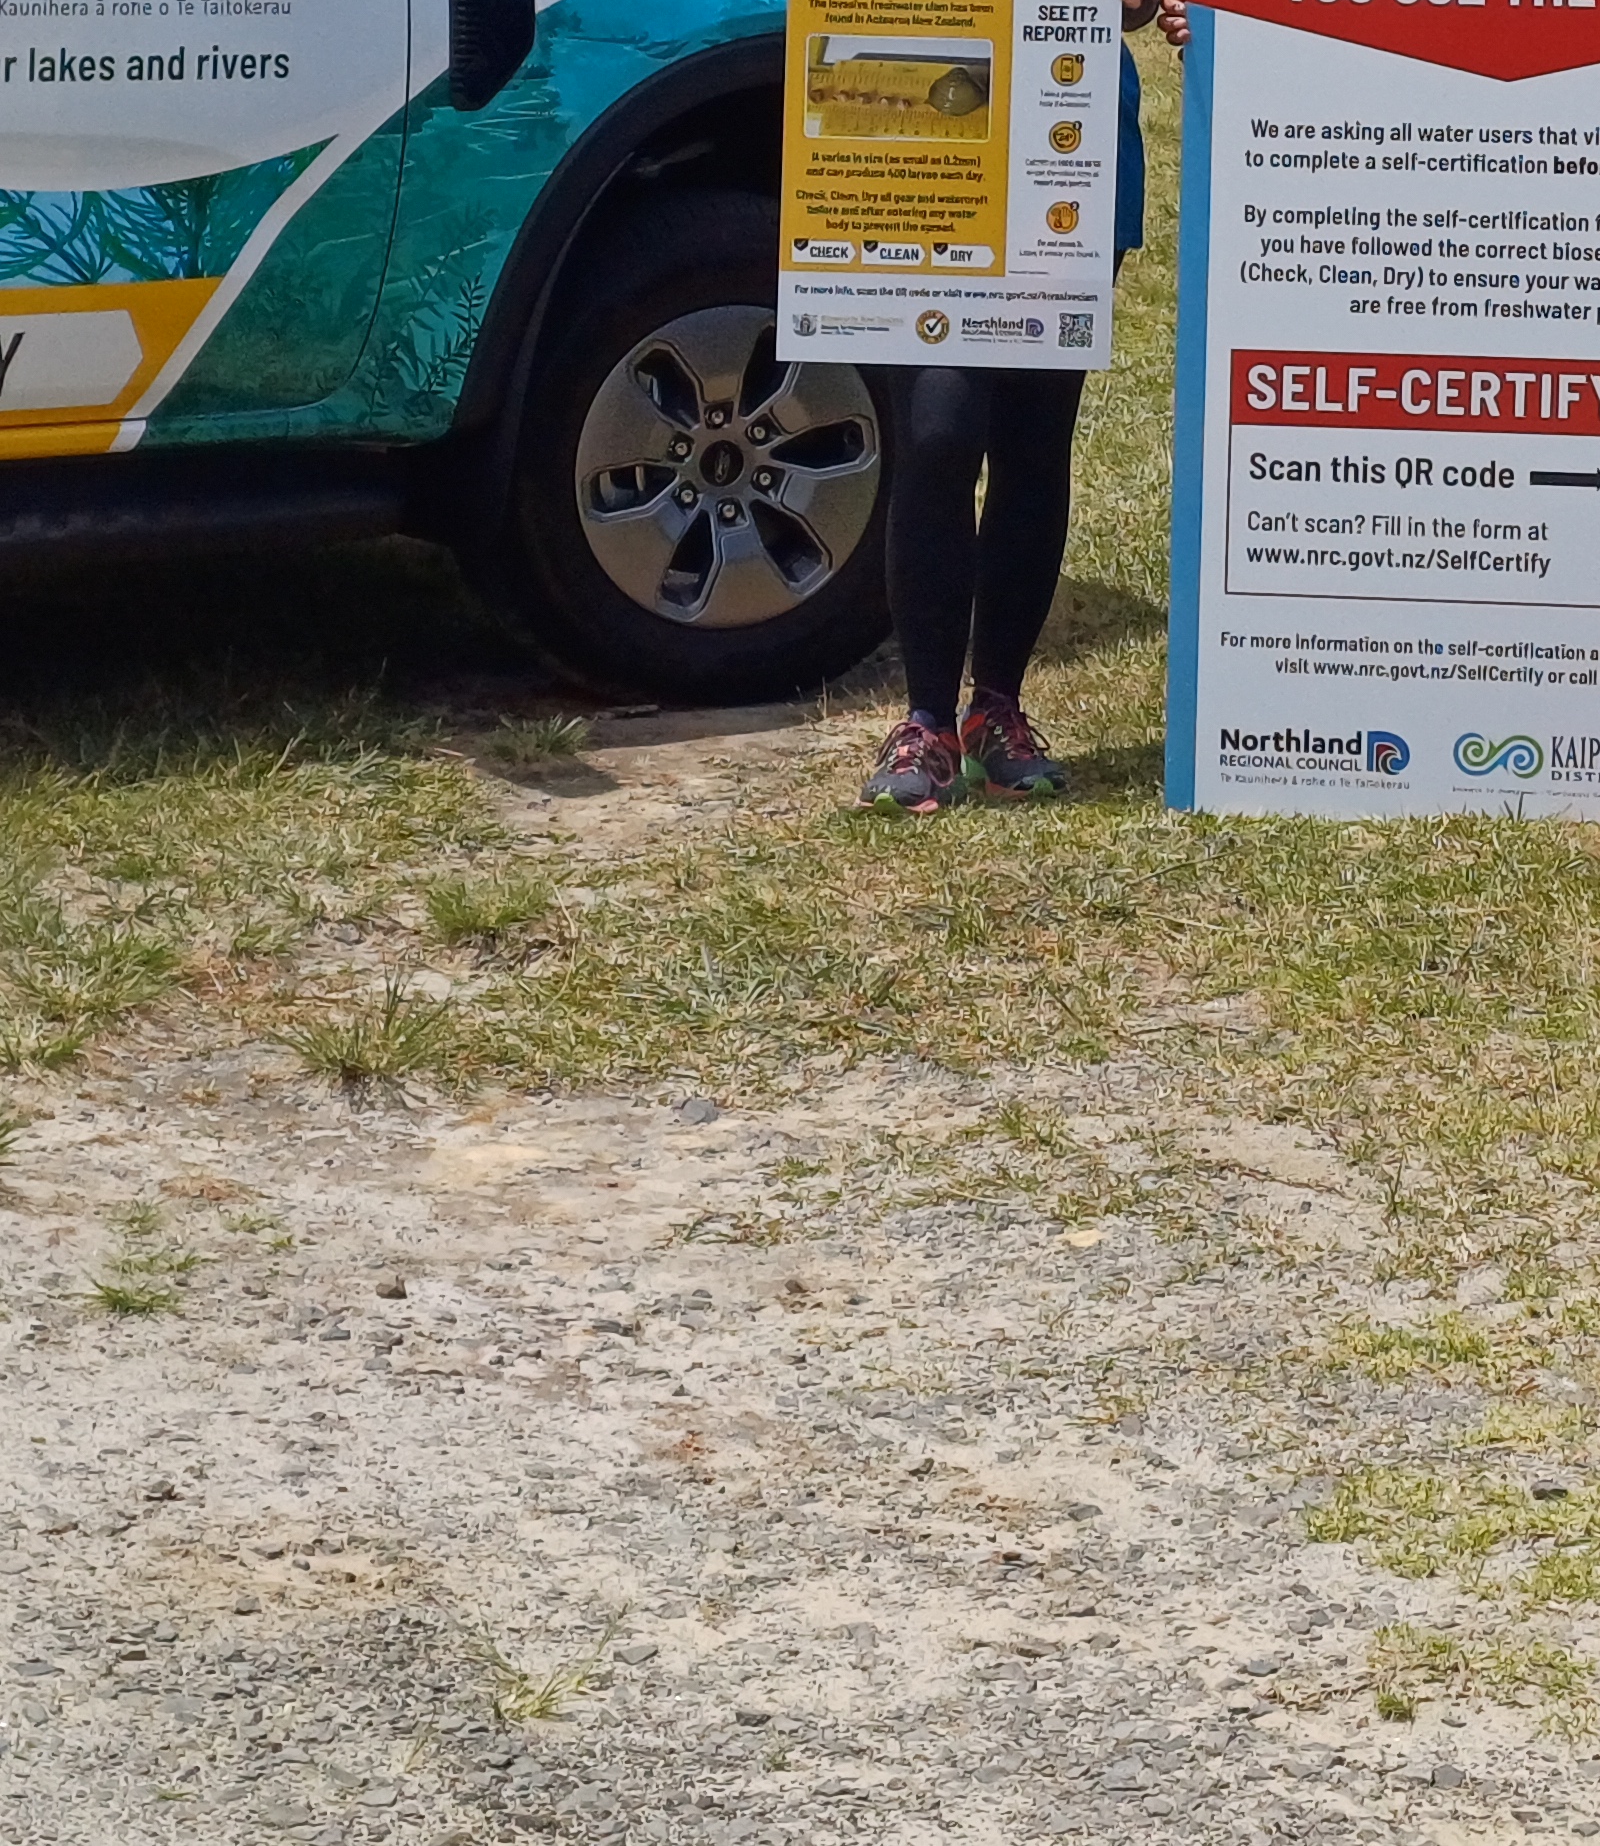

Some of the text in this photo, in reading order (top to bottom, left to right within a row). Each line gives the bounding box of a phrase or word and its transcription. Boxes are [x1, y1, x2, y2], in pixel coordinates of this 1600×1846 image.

[159, 4, 168, 16] o
[1038, 5, 1098, 23] SEE IT?
[1022, 25, 1112, 43] REPORT IT!
[28, 47, 116, 83] lakes
[126, 46, 185, 82] and
[196, 45, 290, 80] rivers
[1250, 118, 1279, 139] We
[1284, 124, 1316, 140] are
[1321, 120, 1385, 146] asking
[1389, 122, 1412, 142] all
[1417, 124, 1474, 143] water
[1478, 128, 1533, 145] users
[1538, 125, 1578, 146] that
[1244, 149, 1264, 168] to
[1269, 150, 1360, 174] complete
[1364, 155, 1376, 170] a
[1382, 151, 1548, 175] self-certification
[1244, 204, 1267, 228] By
[1272, 205, 1381, 231] completing
[1386, 208, 1418, 228] the
[1422, 209, 1589, 233] self-certification
[810, 246, 849, 259] CHECK
[879, 247, 920, 260] CLEAN
[950, 249, 973, 262] DRY
[1260, 238, 1294, 258] you
[1300, 235, 1346, 255] have
[1351, 236, 1433, 257] followed
[1438, 238, 1470, 258] the
[1475, 242, 1548, 260] correct
[1240, 260, 1313, 286] (Check,
[1319, 264, 1378, 288] Clean,
[1383, 266, 1424, 291] Dry)
[1428, 268, 1448, 287] to
[1453, 272, 1520, 289] ensure
[1524, 274, 1570, 294] your
[1349, 299, 1381, 314] are
[1387, 295, 1426, 315] free
[1431, 296, 1478, 317] from
[1484, 298, 1592, 321] freshwater
[1249, 452, 1515, 489] Scan this QR code
[1247, 510, 1548, 541] Can't scan? Fill in the form at
[1246, 547, 1552, 579] www.nrc.govt.nz/SelfCertify
[1220, 631, 1247, 648] For
[1250, 635, 1292, 650] more
[1295, 633, 1390, 654] information
[1393, 641, 1413, 654] on
[1418, 638, 1444, 656] the
[1447, 639, 1586, 661] self-certification
[1275, 657, 1310, 675] visit
[1313, 662, 1544, 687] www.nrc.govt.nz/SelfCertify
[1547, 671, 1566, 684] or
[1569, 669, 1597, 686] call
[1220, 728, 1362, 754] Northland
[1220, 755, 1362, 771] REGIONAL COUNCIL
